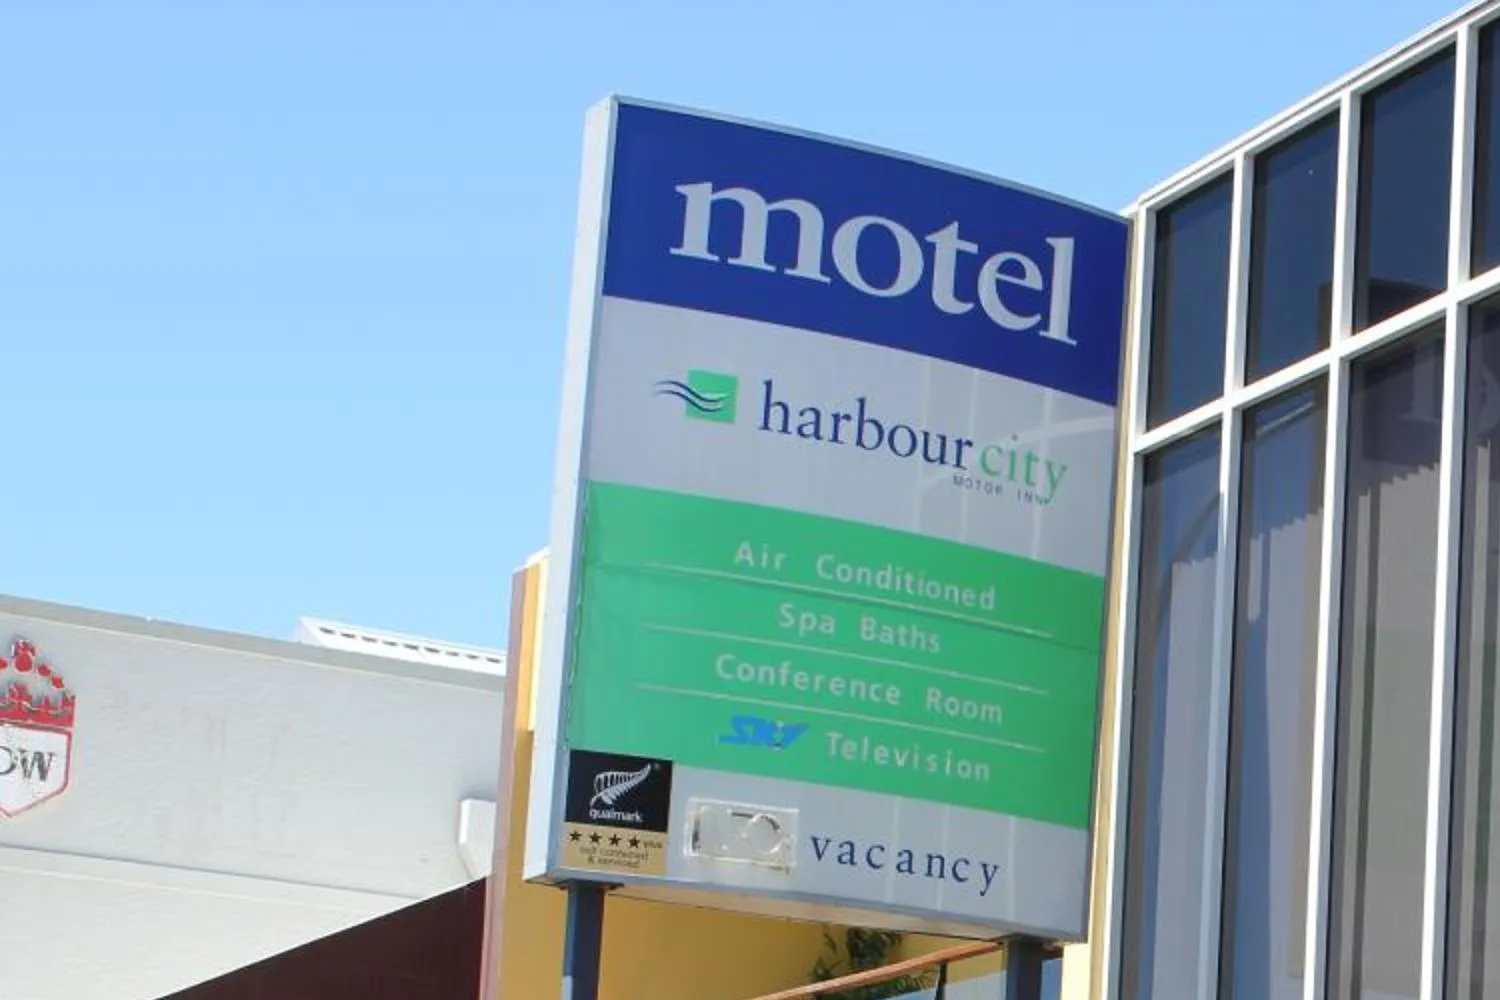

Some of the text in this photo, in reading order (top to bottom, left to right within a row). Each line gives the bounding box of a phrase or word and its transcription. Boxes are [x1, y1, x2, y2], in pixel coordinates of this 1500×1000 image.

[670, 181, 1077, 346] motel
[734, 541, 996, 610] Air Conditioned
[779, 602, 942, 654] Spa Baths
[715, 653, 1003, 726] Conference Room
[824, 731, 992, 782] Television
[589, 808, 643, 824] qualmark
[809, 834, 1001, 897] vacancy
